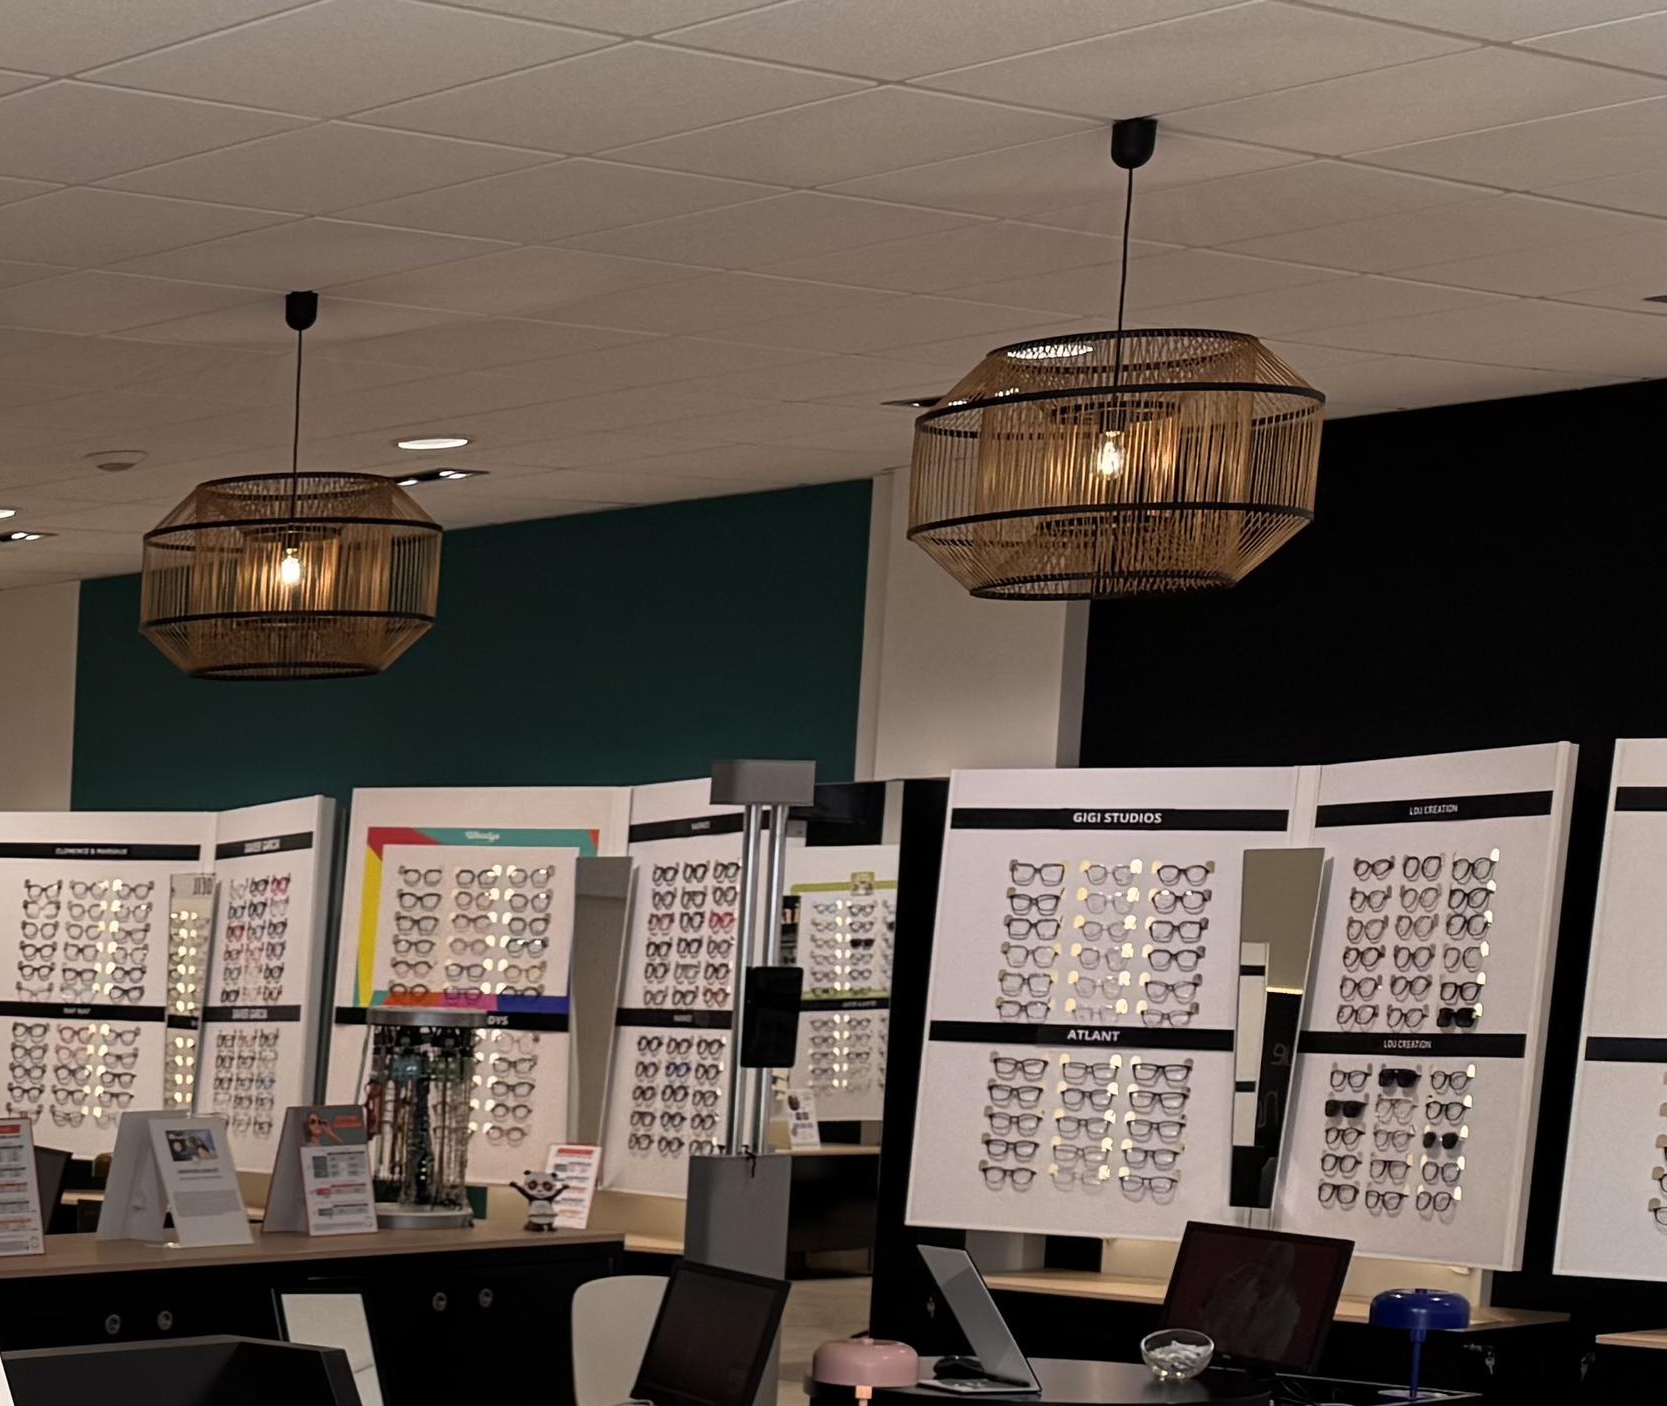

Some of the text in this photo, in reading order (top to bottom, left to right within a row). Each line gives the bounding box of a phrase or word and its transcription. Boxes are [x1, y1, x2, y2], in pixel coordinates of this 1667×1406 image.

[1072, 812, 1163, 824] GIGI STUDIOS
[1066, 1029, 1121, 1042] ATLANT
